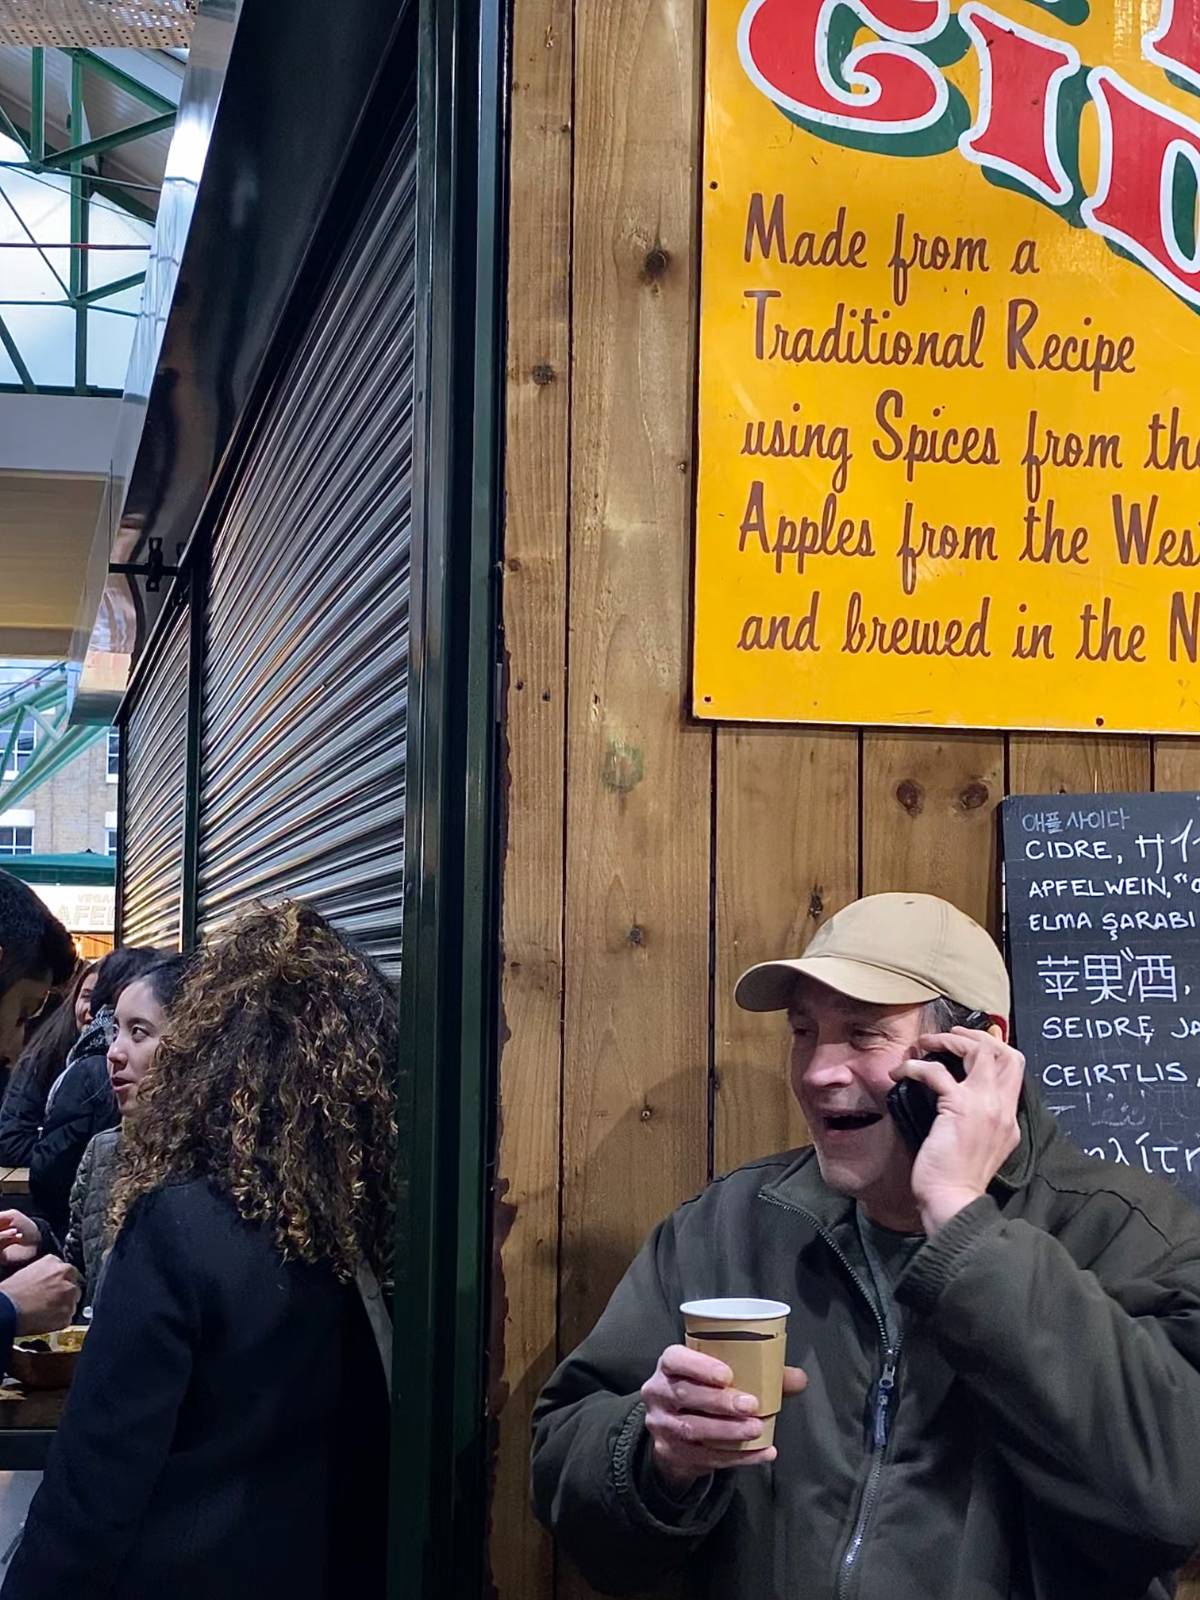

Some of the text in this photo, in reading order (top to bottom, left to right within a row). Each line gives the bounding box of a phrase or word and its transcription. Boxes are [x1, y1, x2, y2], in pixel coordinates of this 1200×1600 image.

[744, 193, 1040, 307] Made from a
[744, 290, 1135, 391] Traditional Recipe
[741, 390, 1200, 502] using Spices from th
[739, 480, 1200, 595] Apples from the Wes
[737, 591, 820, 651] and
[842, 592, 990, 657] brewed
[1012, 604, 1054, 659] in
[1076, 597, 1145, 662] the
[1026, 840, 1122, 864] CIDRE,
[1135, 819, 1200, 875] サイ
[1029, 911, 1195, 940] ELMA ŞARABI
